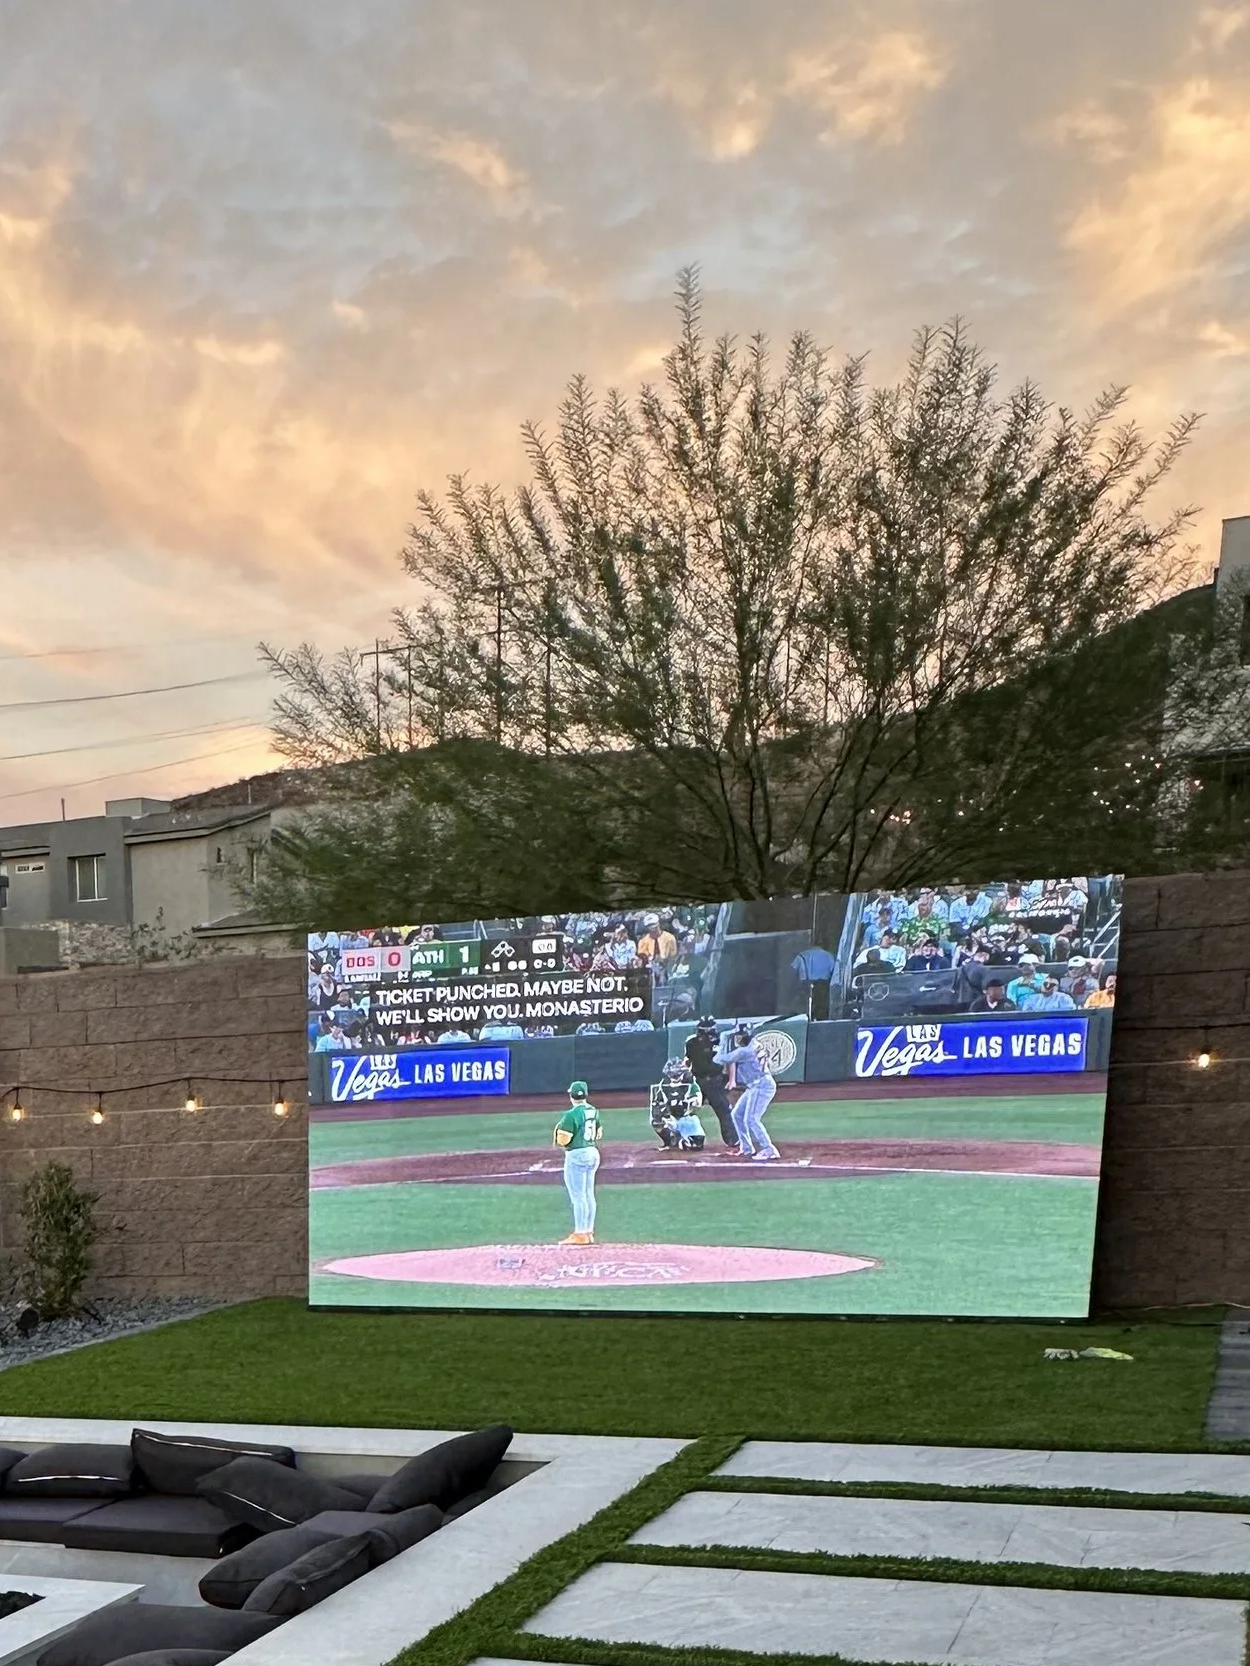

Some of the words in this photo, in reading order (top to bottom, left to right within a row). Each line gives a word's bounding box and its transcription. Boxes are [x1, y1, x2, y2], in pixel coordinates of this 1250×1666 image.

[412, 949, 444, 964] ATH
[459, 945, 469, 963] 1
[376, 988, 434, 1006] TICKET
[524, 979, 584, 997] MAYBE
[586, 975, 628, 993] NOT.
[376, 1009, 425, 1026] WE'LL
[427, 1005, 480, 1023] SHOW
[483, 1003, 523, 1019] YOU.
[525, 996, 644, 1018] MONASTERIO
[855, 1025, 958, 1077] Vegas
[963, 1036, 1003, 1059] LAS
[1011, 1033, 1082, 1057] VEGAS
[332, 1055, 411, 1102] Vegas
[415, 1063, 445, 1084] LAS
[452, 1060, 506, 1083] VEGAS
